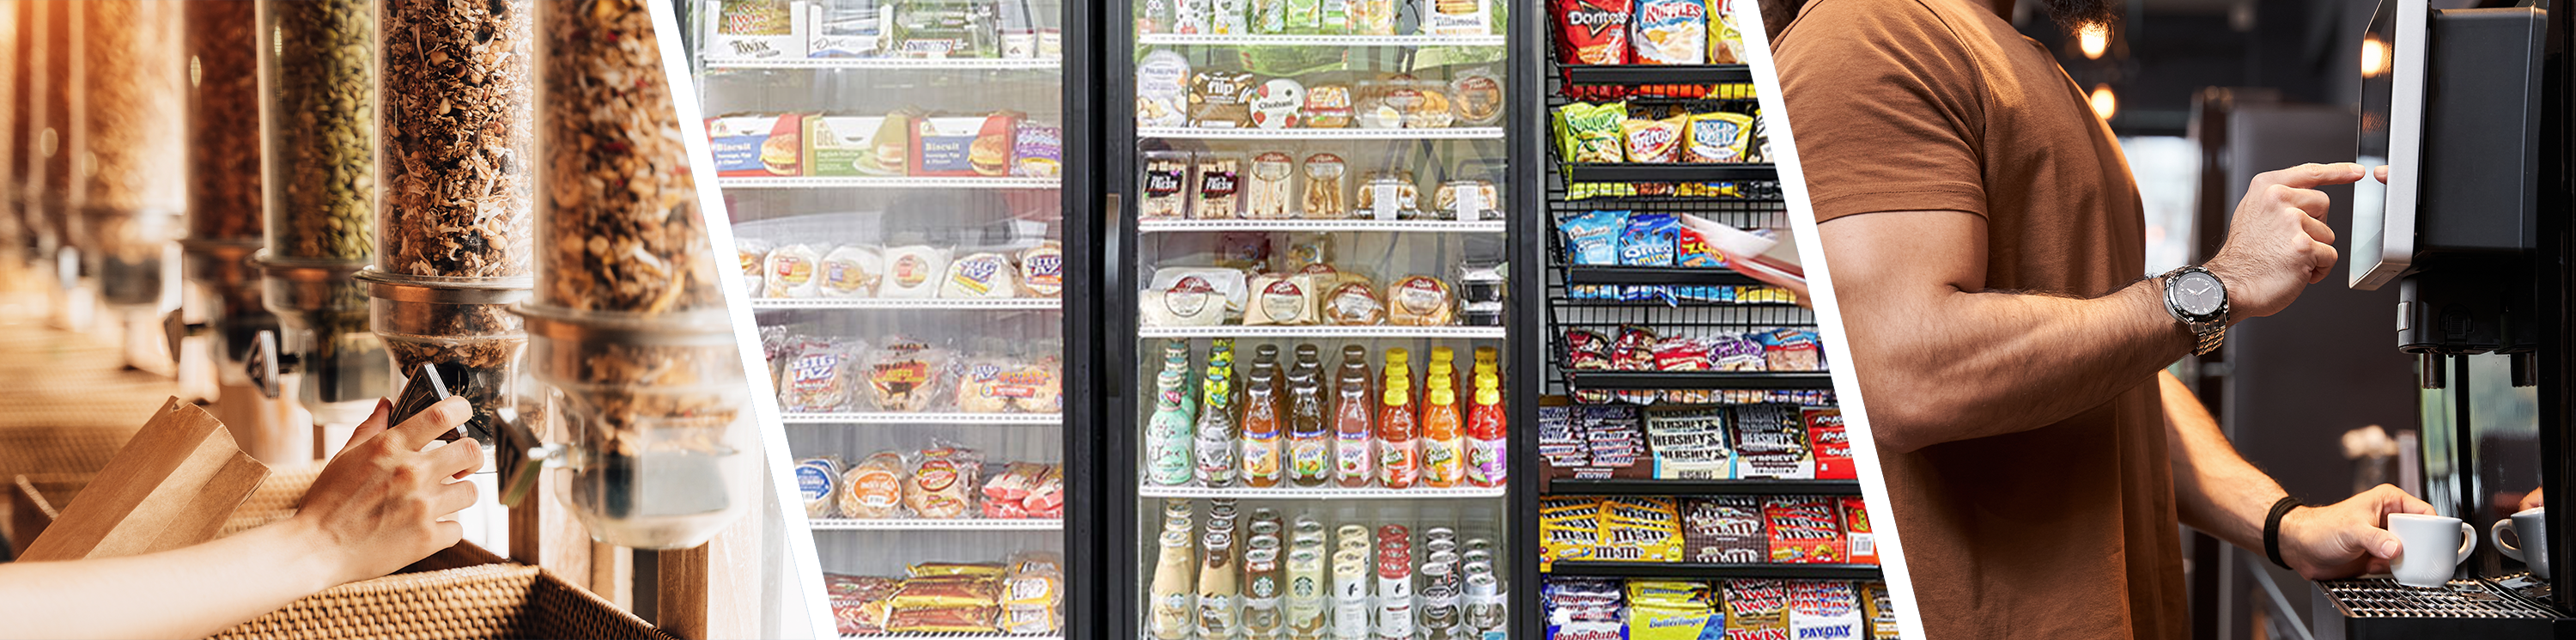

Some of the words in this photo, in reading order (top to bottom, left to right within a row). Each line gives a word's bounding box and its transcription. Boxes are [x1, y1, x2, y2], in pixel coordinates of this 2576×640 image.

[1569, 10, 1629, 25] Doritos
[1643, 3, 1703, 23] RUFFLES
[1258, 100, 1294, 110] Chobani
[1630, 126, 1672, 153] Fritos
[716, 143, 751, 152] Biscuit
[925, 143, 960, 151] Biscuit
[793, 354, 838, 370] BIG
[795, 366, 834, 382] AZ
[1649, 616, 1707, 629] Butterfinger
[1799, 625, 1851, 639] PAYDAY
